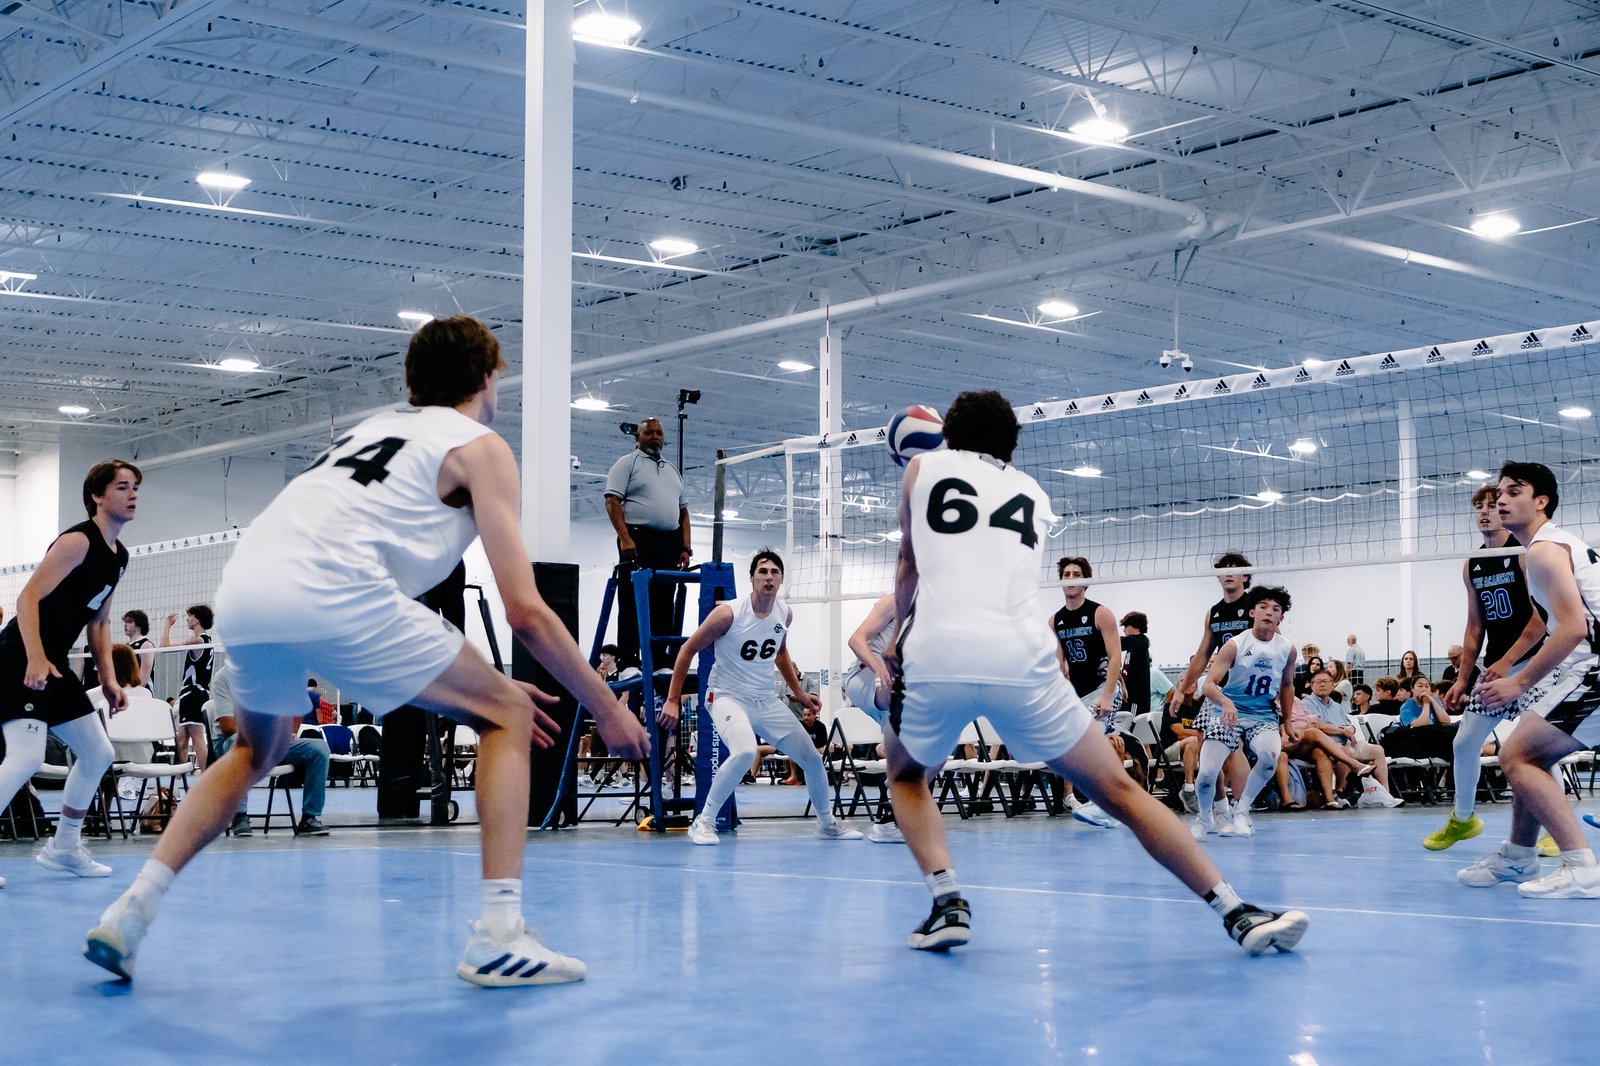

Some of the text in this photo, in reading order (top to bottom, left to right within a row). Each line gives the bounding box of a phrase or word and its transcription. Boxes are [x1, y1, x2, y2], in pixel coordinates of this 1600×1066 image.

[1252, 381, 1271, 389] adidas
[1294, 375, 1312, 383] adidas
[1335, 368, 1355, 376] adidas
[1379, 362, 1400, 370] adidas
[1425, 355, 1445, 364] adidas
[1471, 348, 1494, 357] adidas
[1520, 341, 1543, 350] adidas
[1570, 334, 1593, 343] adidas
[926, 477, 1038, 550] 64
[1483, 571, 1515, 588] ACADEMY
[1481, 588, 1513, 620] 20
[740, 638, 776, 661] 66
[1066, 639, 1087, 662] 16
[1244, 674, 1272, 696] 18
